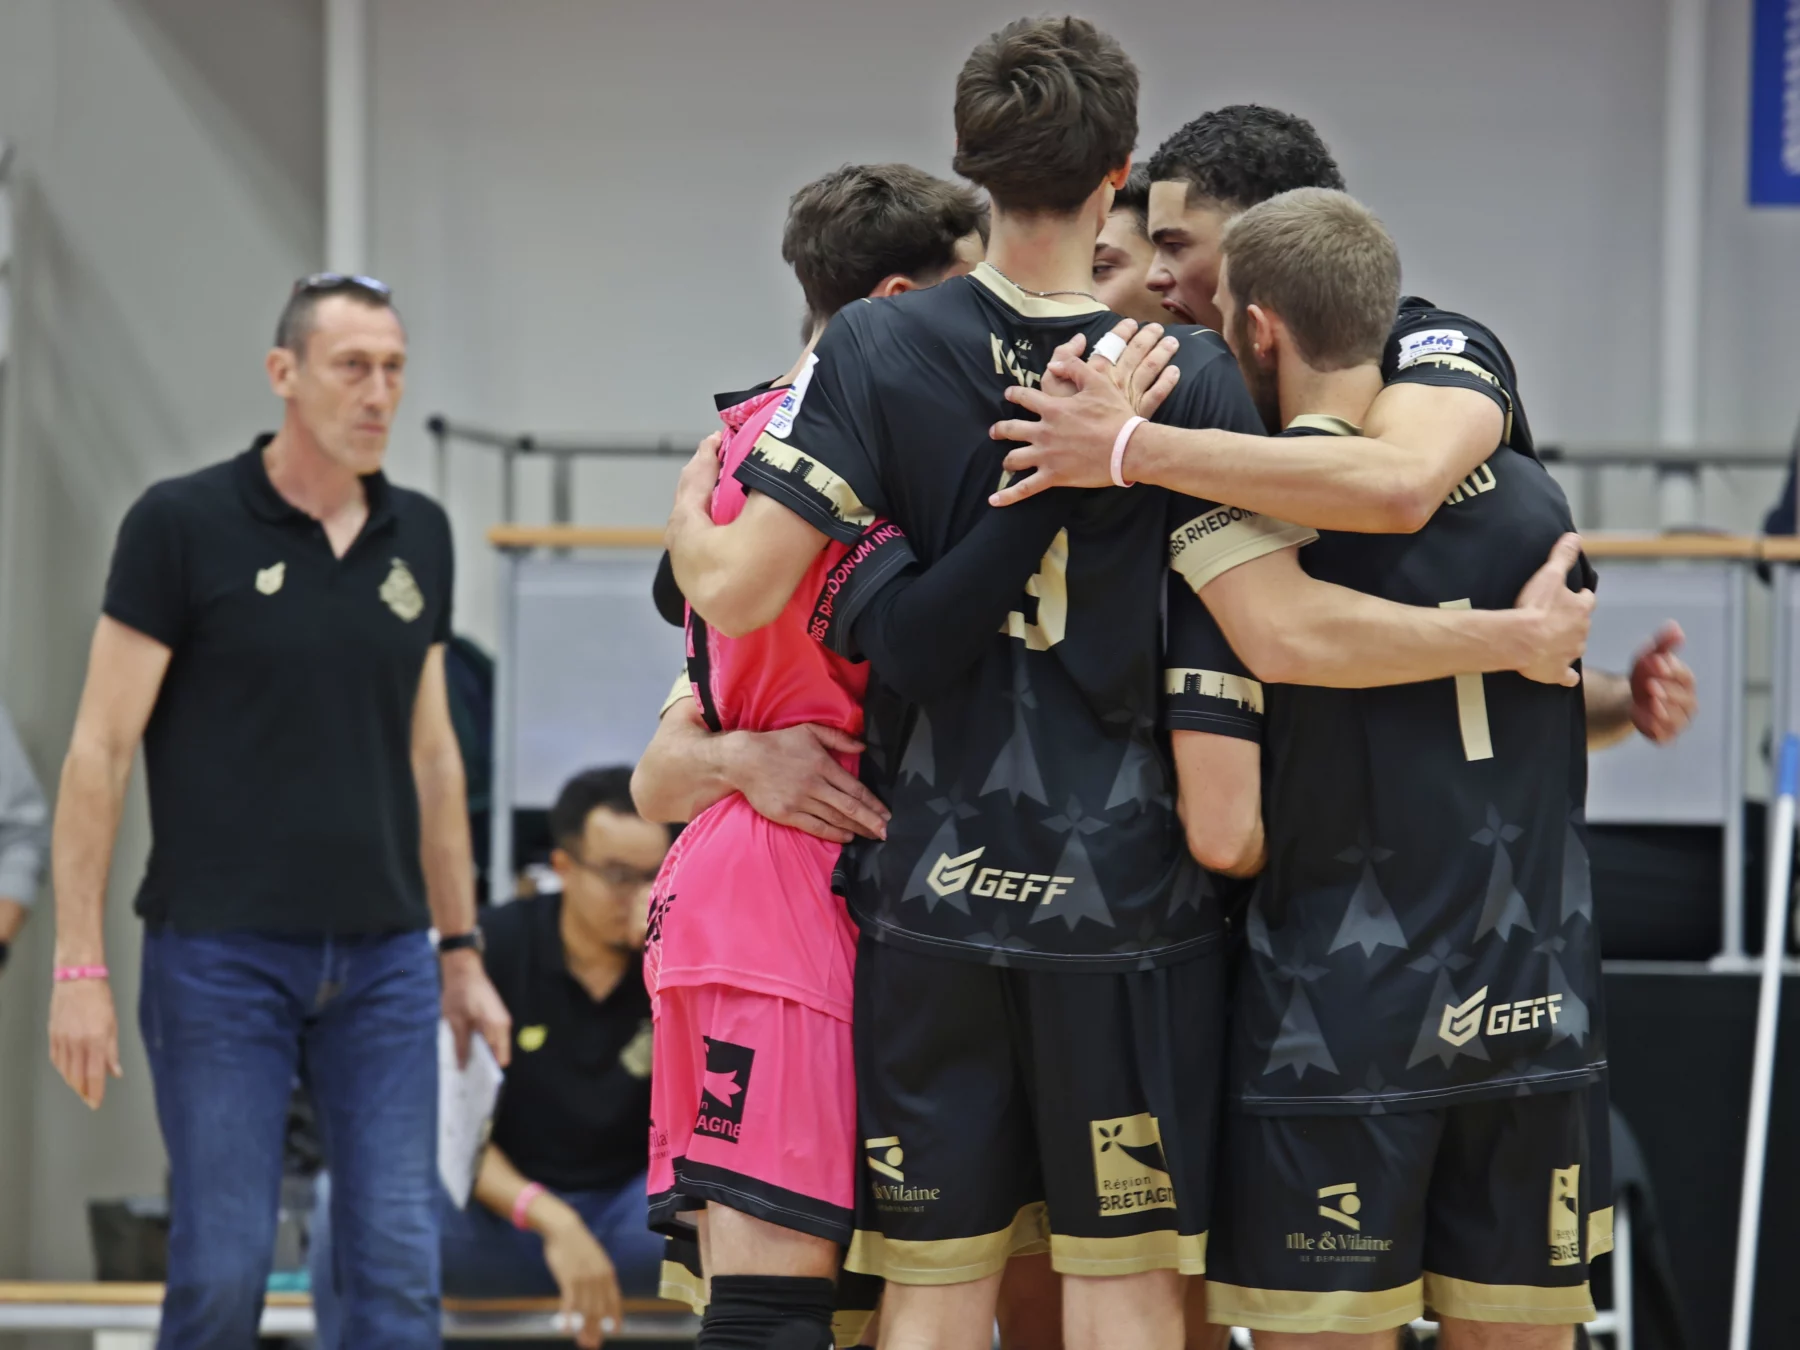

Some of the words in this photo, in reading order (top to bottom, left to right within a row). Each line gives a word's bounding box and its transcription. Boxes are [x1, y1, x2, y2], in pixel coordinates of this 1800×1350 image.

[1185, 505, 1259, 543] RHEDON
[970, 867, 1075, 905] GEFF
[1486, 993, 1563, 1036] GEFF
[1103, 1176, 1152, 1191] Région
[1286, 1232, 1315, 1250] Ille
